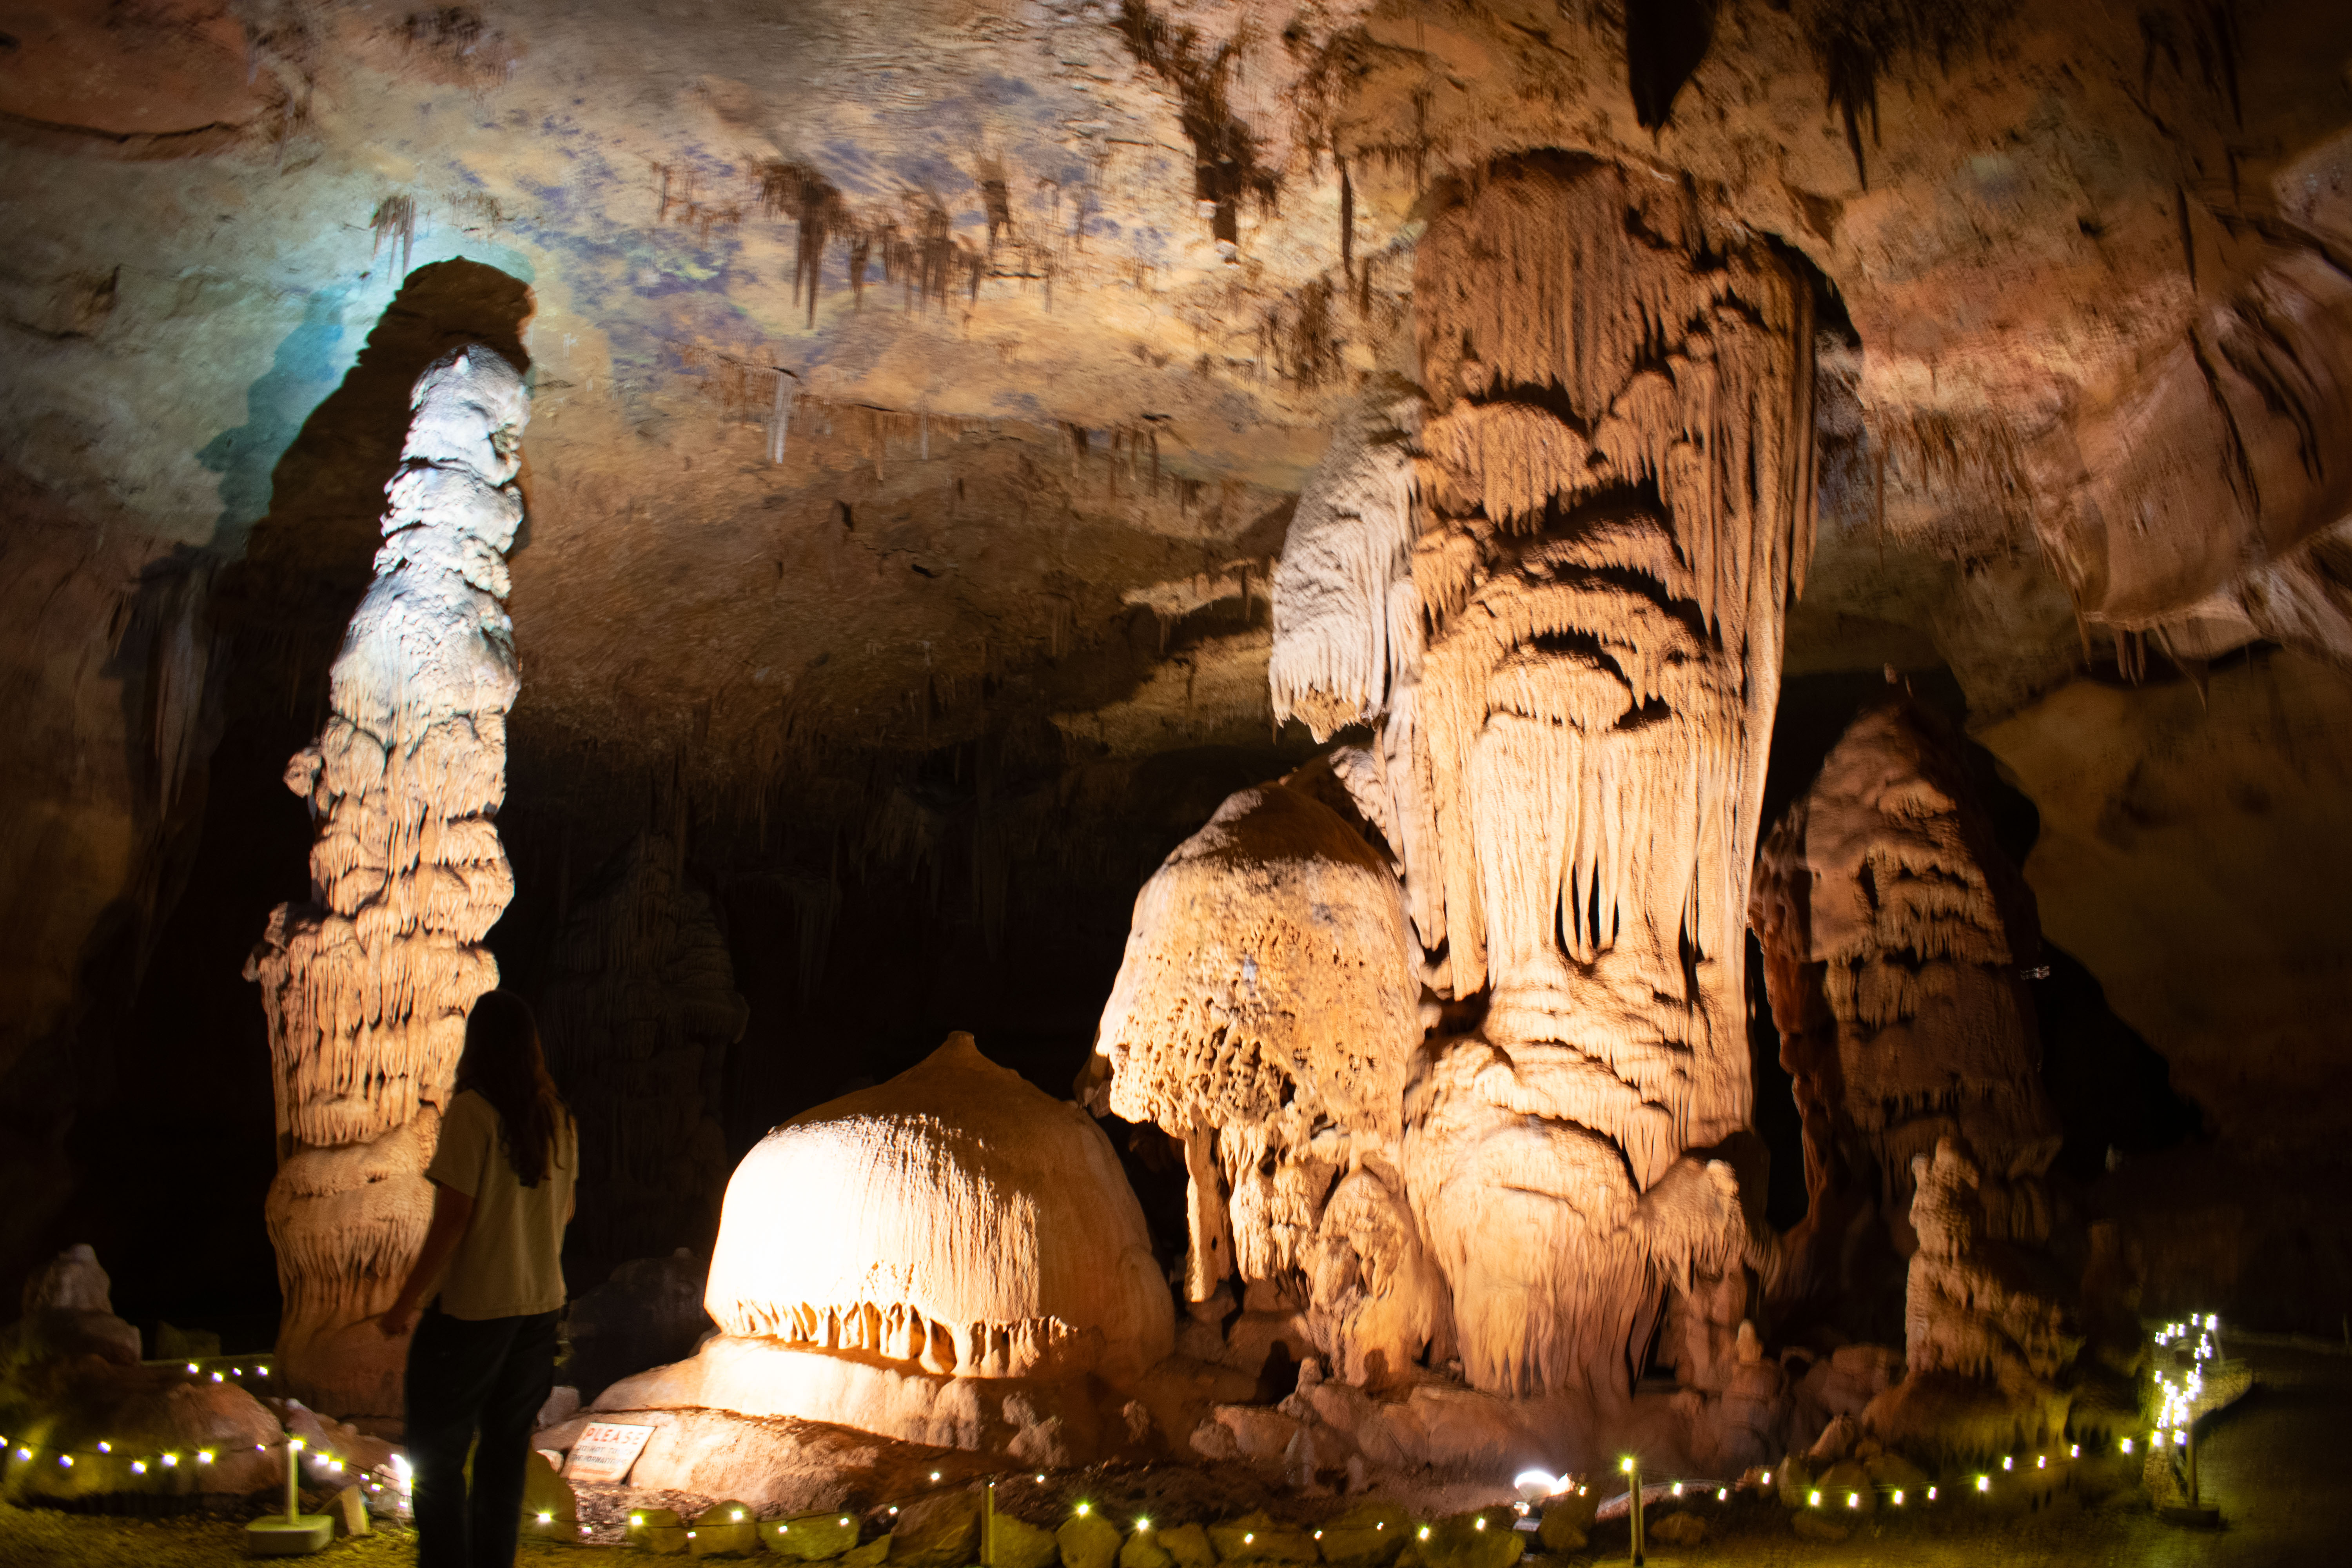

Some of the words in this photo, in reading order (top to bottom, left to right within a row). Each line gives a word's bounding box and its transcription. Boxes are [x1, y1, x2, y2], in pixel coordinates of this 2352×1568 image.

[583, 1428, 644, 1445] PLEASE
[608, 1447, 633, 1455] TOCH
[585, 1455, 627, 1465] ORMATIOS
